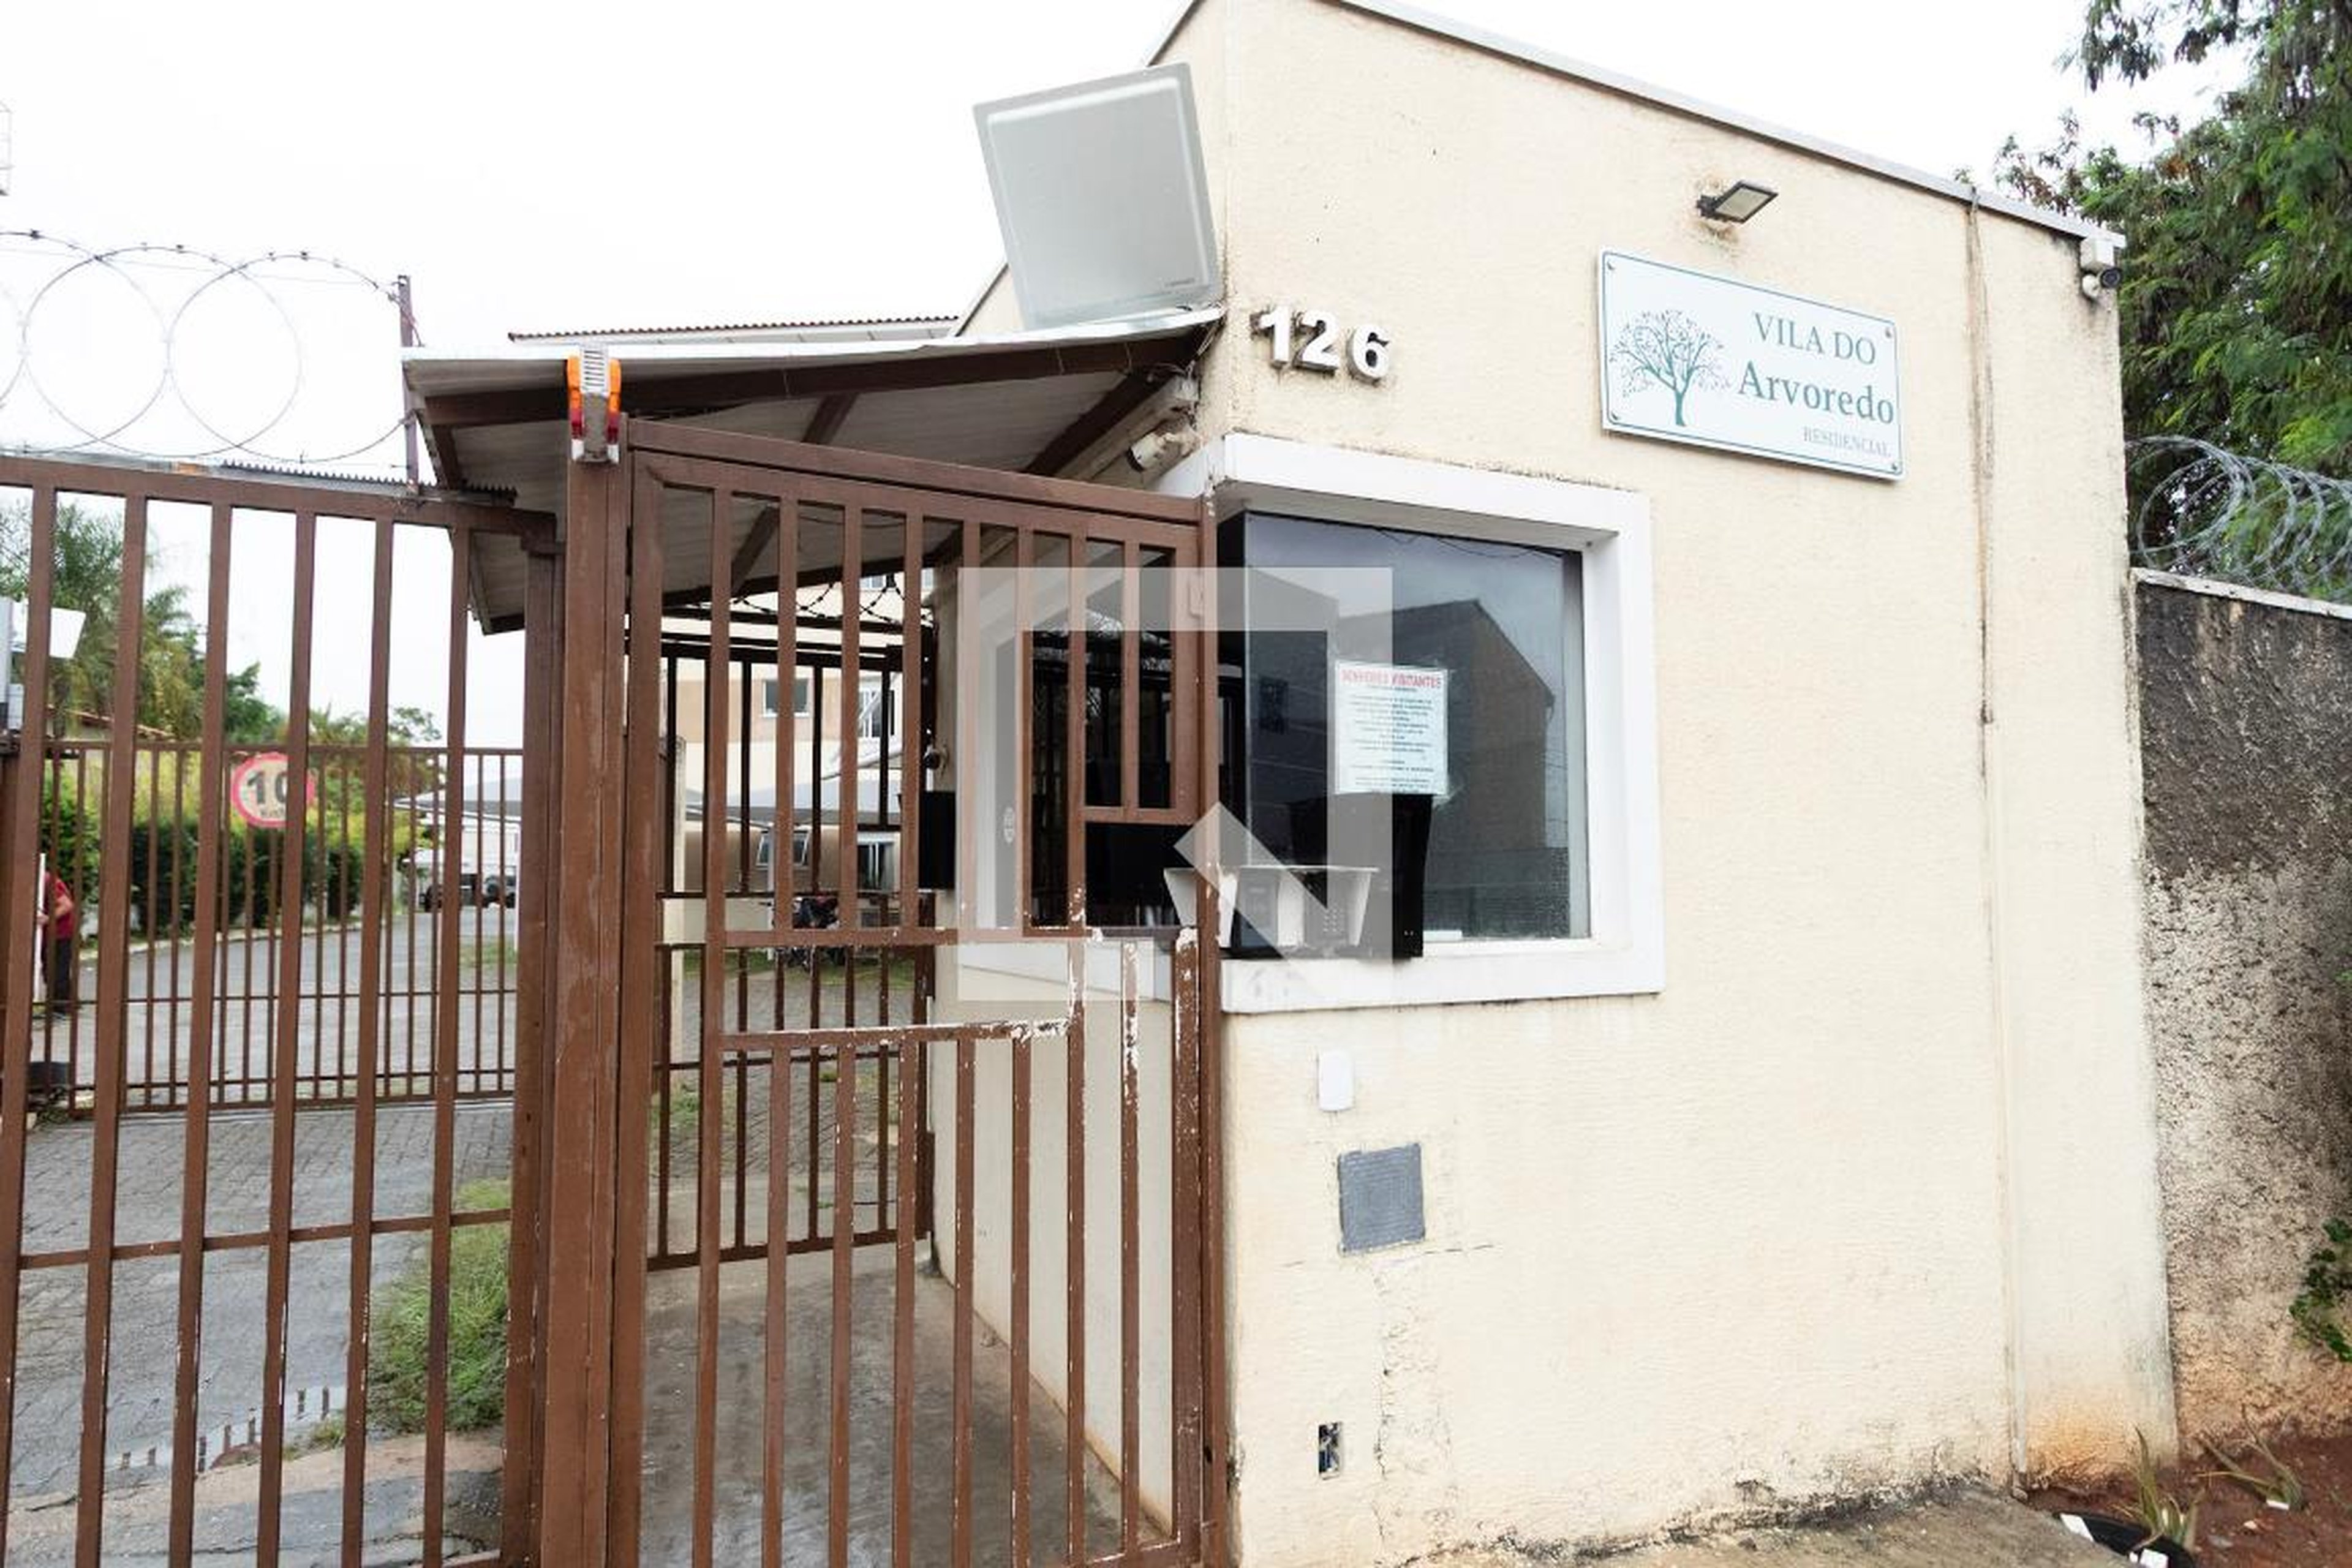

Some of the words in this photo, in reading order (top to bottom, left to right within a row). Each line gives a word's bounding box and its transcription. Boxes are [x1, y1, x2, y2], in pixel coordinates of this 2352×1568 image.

[1253, 305, 1390, 382] 126
[1754, 311, 1825, 355] VILA
[1833, 331, 1877, 365] DO
[1738, 360, 1895, 424] Arvoredo
[1803, 425, 1891, 458] RESIDENCIAL
